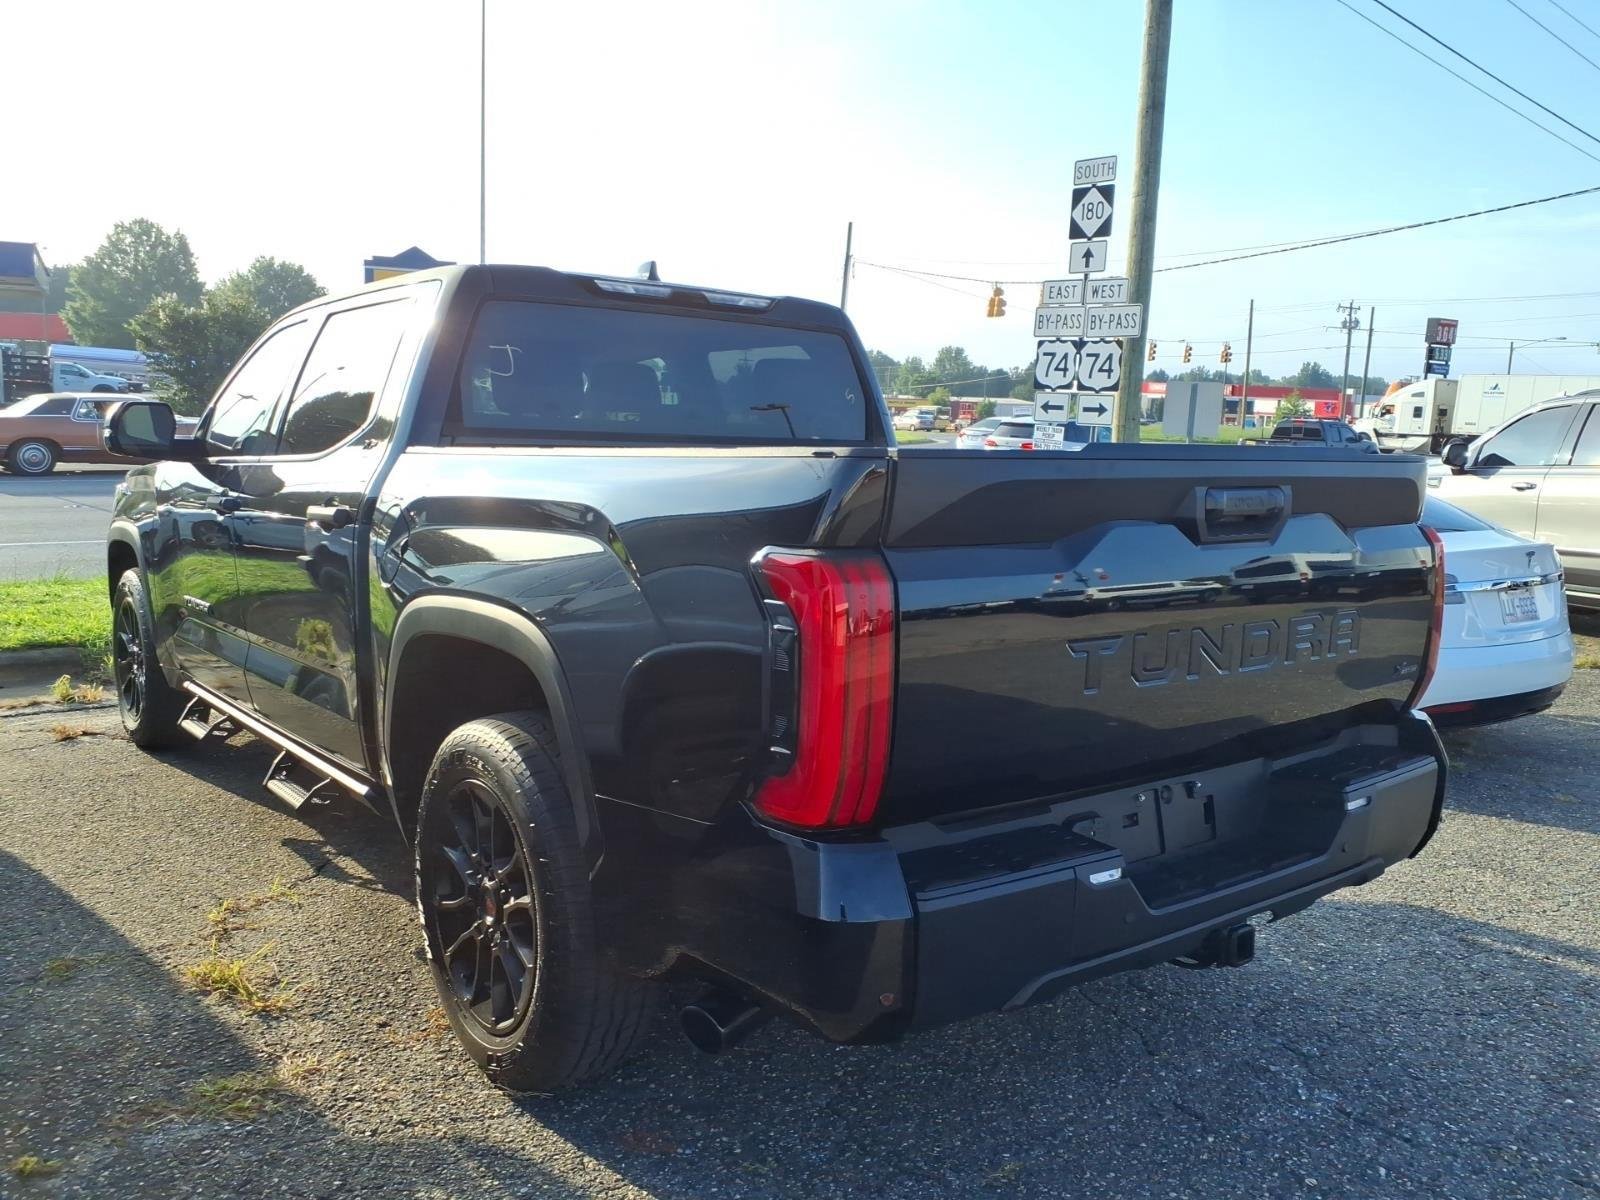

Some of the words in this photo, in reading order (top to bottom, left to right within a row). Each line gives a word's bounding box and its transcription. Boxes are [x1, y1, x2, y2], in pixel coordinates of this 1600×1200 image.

[1076, 161, 1115, 180] SOUTH
[1081, 200, 1105, 221] 180
[1048, 284, 1078, 300] EAST
[1091, 283, 1124, 299] WEST
[1037, 313, 1082, 330] BY-PASS
[1089, 312, 1138, 331] BY-PASS
[1042, 351, 1069, 378] 74
[1085, 352, 1114, 379] 74
[1065, 609, 1361, 695] TUNDRA
